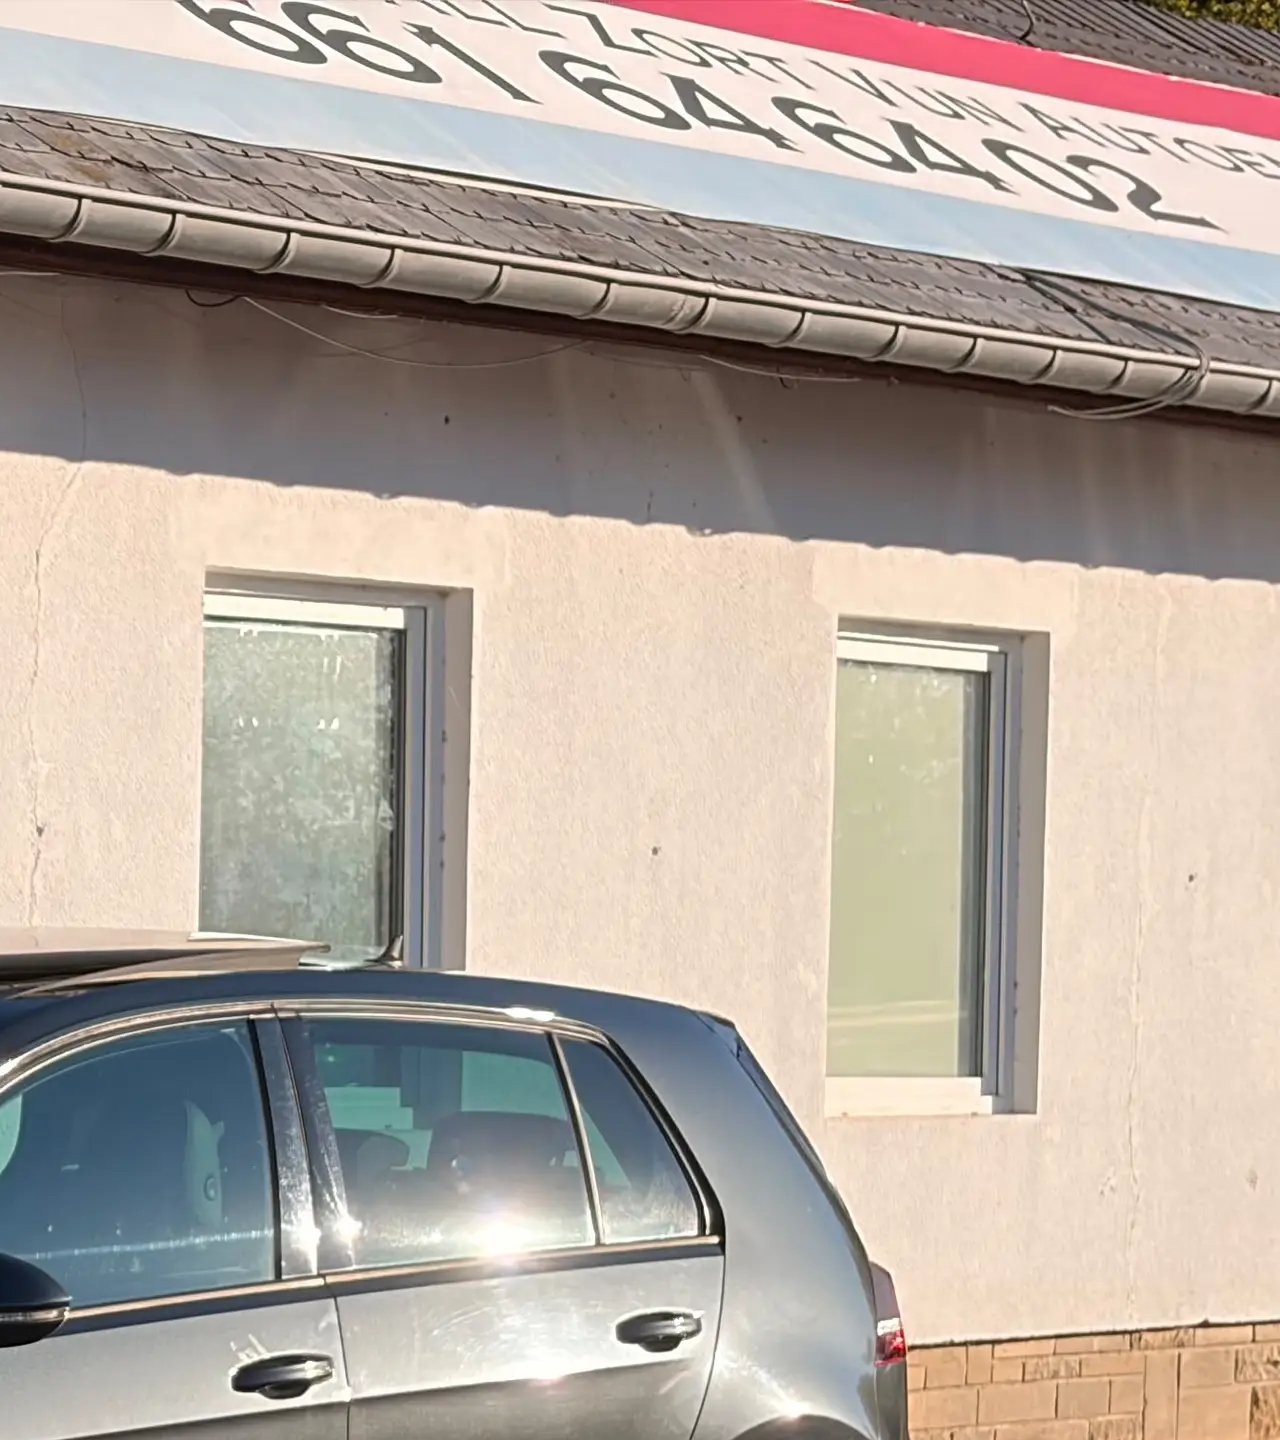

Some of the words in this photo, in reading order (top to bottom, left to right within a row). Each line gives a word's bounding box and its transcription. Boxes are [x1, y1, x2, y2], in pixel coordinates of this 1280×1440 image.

[175, 0, 543, 104] 661
[542, 2, 815, 90] ZORT
[810, 59, 1025, 132] VUN
[1017, 101, 1280, 179] AUTOE
